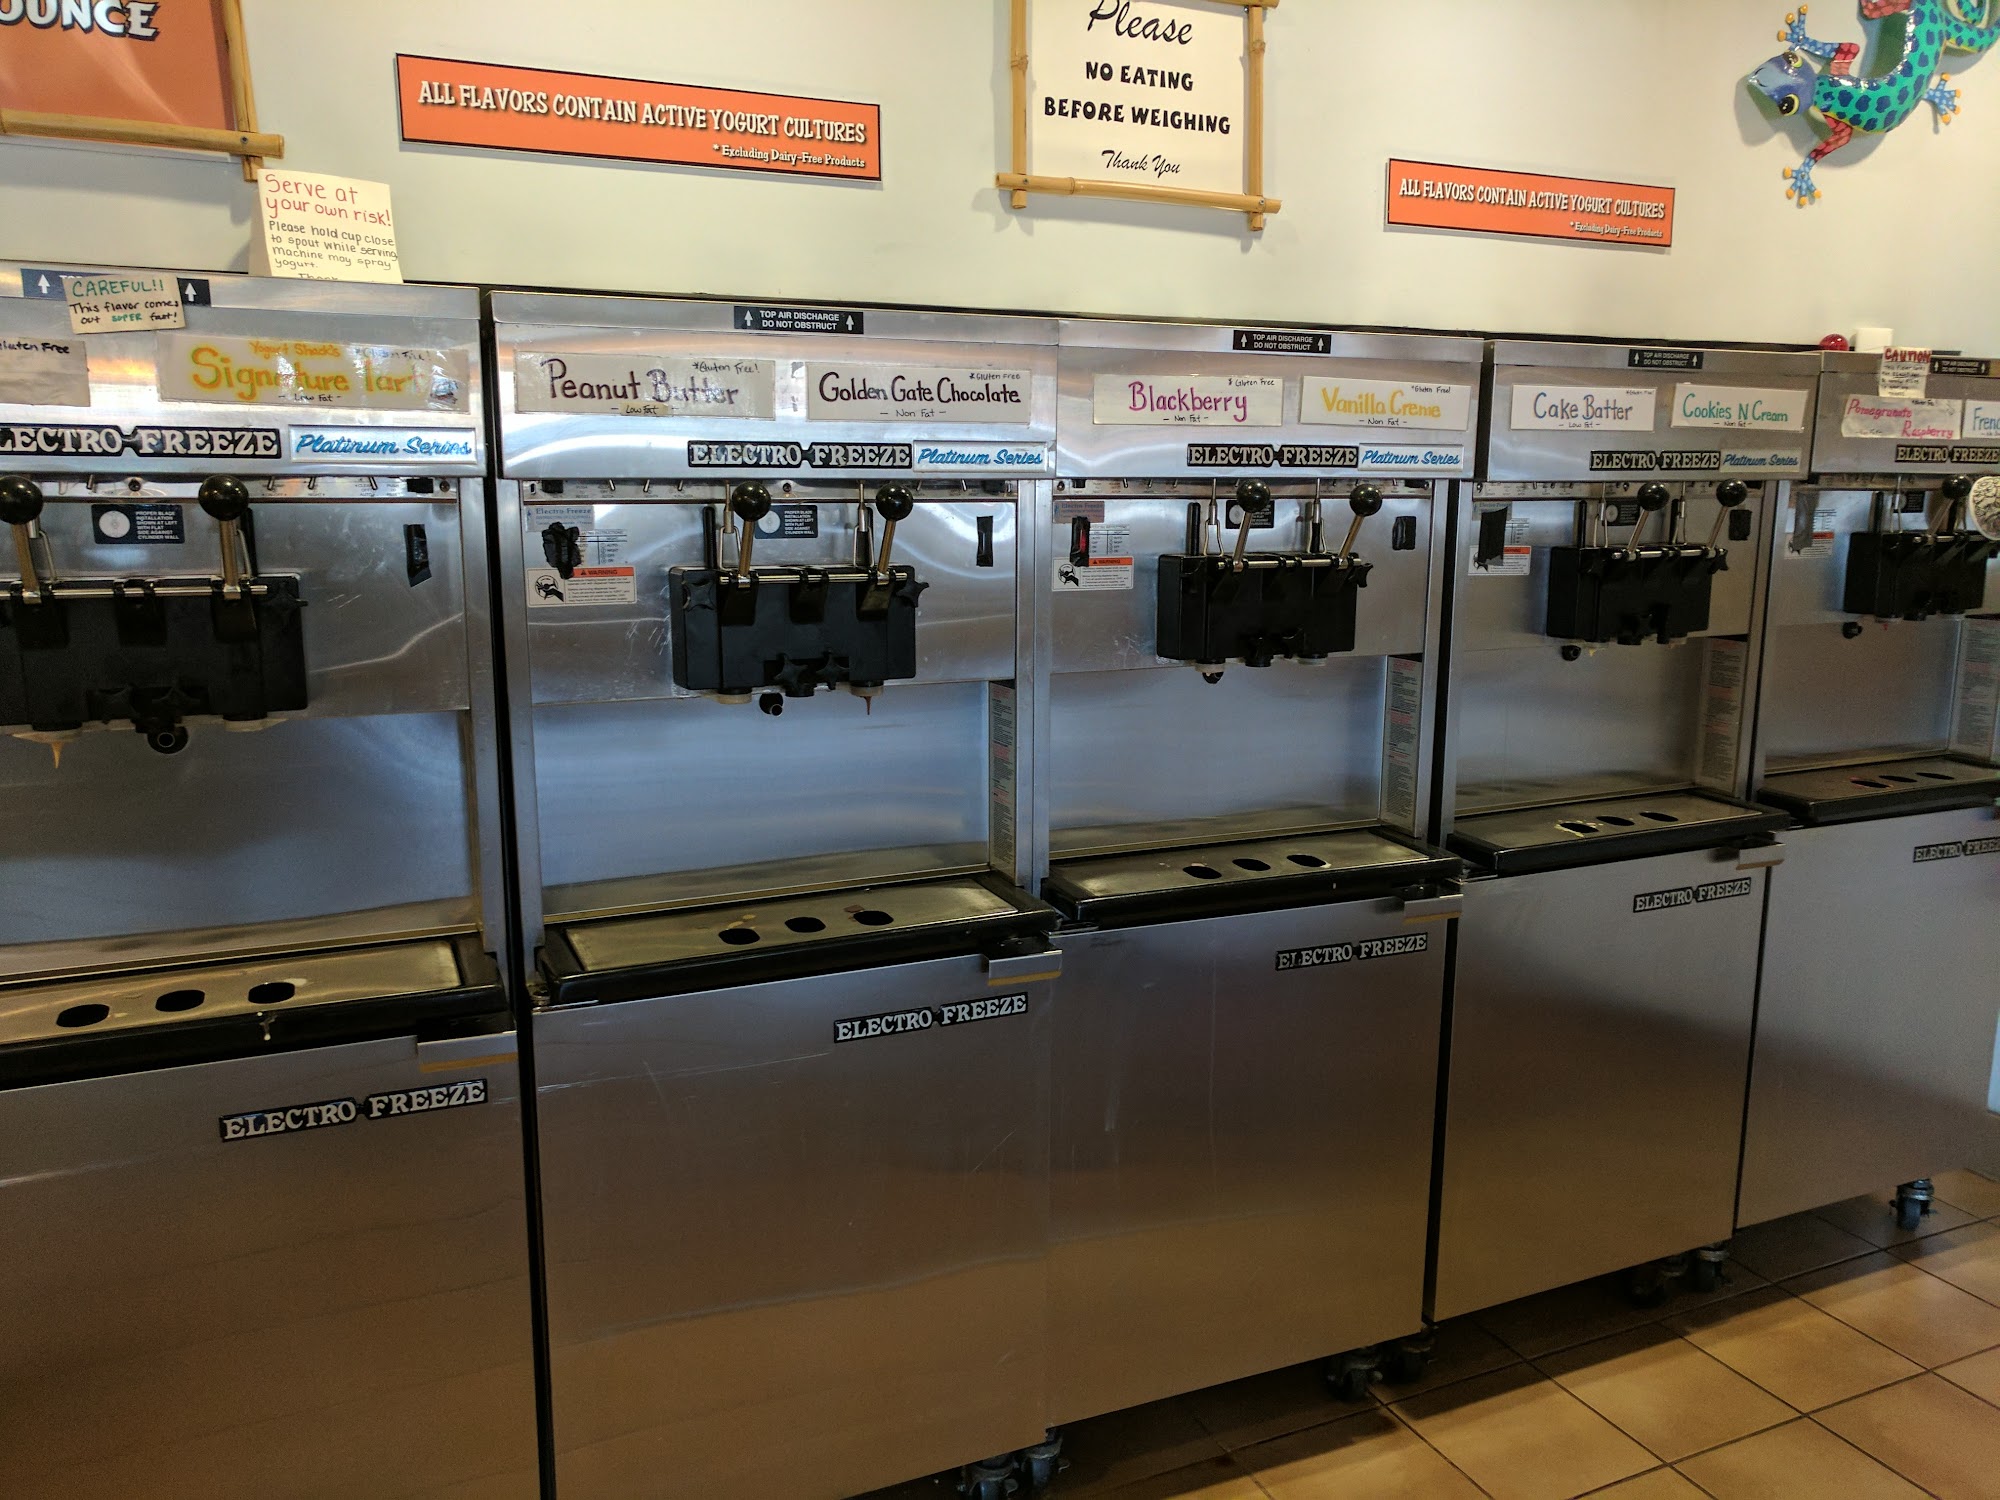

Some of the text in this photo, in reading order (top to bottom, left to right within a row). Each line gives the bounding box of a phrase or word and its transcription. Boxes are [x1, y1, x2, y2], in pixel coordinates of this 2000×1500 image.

[1087, 0, 1192, 45] Please
[1086, 62, 1193, 91] NO EATING
[418, 80, 866, 143] ALL FLAVORS CONTAIN ACTIVE YOGURT CULTURES
[1044, 96, 1231, 135] BEFORE WEIGHING
[772, 150, 823, 166] Dairy-Free
[825, 156, 865, 168] Products
[1101, 150, 1181, 178] Thank You
[265, 173, 358, 204] Serve at
[1399, 178, 1665, 219] ALL FLAVORS CONTAIN ACTIVE YOGURT CULTURES
[266, 197, 392, 227] your own risk!
[269, 220, 395, 247] Please hold cup close
[271, 234, 398, 261] to spout while serving
[272, 246, 392, 271] machine may spray
[274, 258, 318, 270] yogurt.
[72, 279, 164, 298] CAREFUL!!
[69, 300, 180, 316] This flavor comes
[759, 310, 840, 322] TOP AIR DISCHARGE
[80, 311, 178, 325] out SUPER fast!
[762, 320, 838, 331] DO NOT OBSTRUCT
[0, 340, 70, 354] luten Free
[1252, 333, 1313, 343] TOP AIR DISCHARGE
[1278, 343, 1311, 351] OBSTRUCT
[249, 340, 289, 359] Yogurt
[1663, 352, 1690, 360] DISCHARGE
[1884, 348, 1931, 364] CAUTION
[734, 362, 760, 375] Free!
[1002, 373, 1021, 381] Free
[540, 358, 739, 405] Peanut Butter
[818, 371, 1021, 404] Golden Gate Chocolate
[1260, 378, 1275, 386] Free
[318, 393, 335, 402] Fat
[1128, 380, 1248, 423] Blackberry
[1321, 387, 1442, 418] Vanilla Creme
[1533, 391, 1633, 421] Cake Batter
[1682, 392, 1788, 422] Cookies N Cream
[625, 404, 660, 415] Low Fat
[896, 408, 937, 418] Non Fat
[1189, 414, 1201, 423] Fat
[1387, 417, 1400, 426] Fat
[1901, 420, 1954, 439] Raspberry
[139, 429, 279, 456] FREEZE
[295, 433, 472, 456] Platinum Series
[691, 443, 912, 468] ELECTRO FREEZE
[917, 448, 1043, 465] Platinum Series
[1189, 446, 1358, 466] ELECTRO FREEZE
[1361, 450, 1461, 465] Platinum Series
[1591, 452, 1721, 469] ELECTRO FREEZE
[1722, 453, 1798, 467] Platinum Series
[1897, 446, 2000, 461] ELECTRO FREEZE
[536, 507, 564, 515] Electro
[1915, 843, 1961, 861] ELECTRO
[1635, 879, 1751, 912] ELECTRO FREEZE
[1277, 934, 1428, 970] ELECTRO FREEZE
[835, 994, 1028, 1042] ELECTRO FREEZE
[222, 1080, 486, 1141] ELECTRO FREEZE
